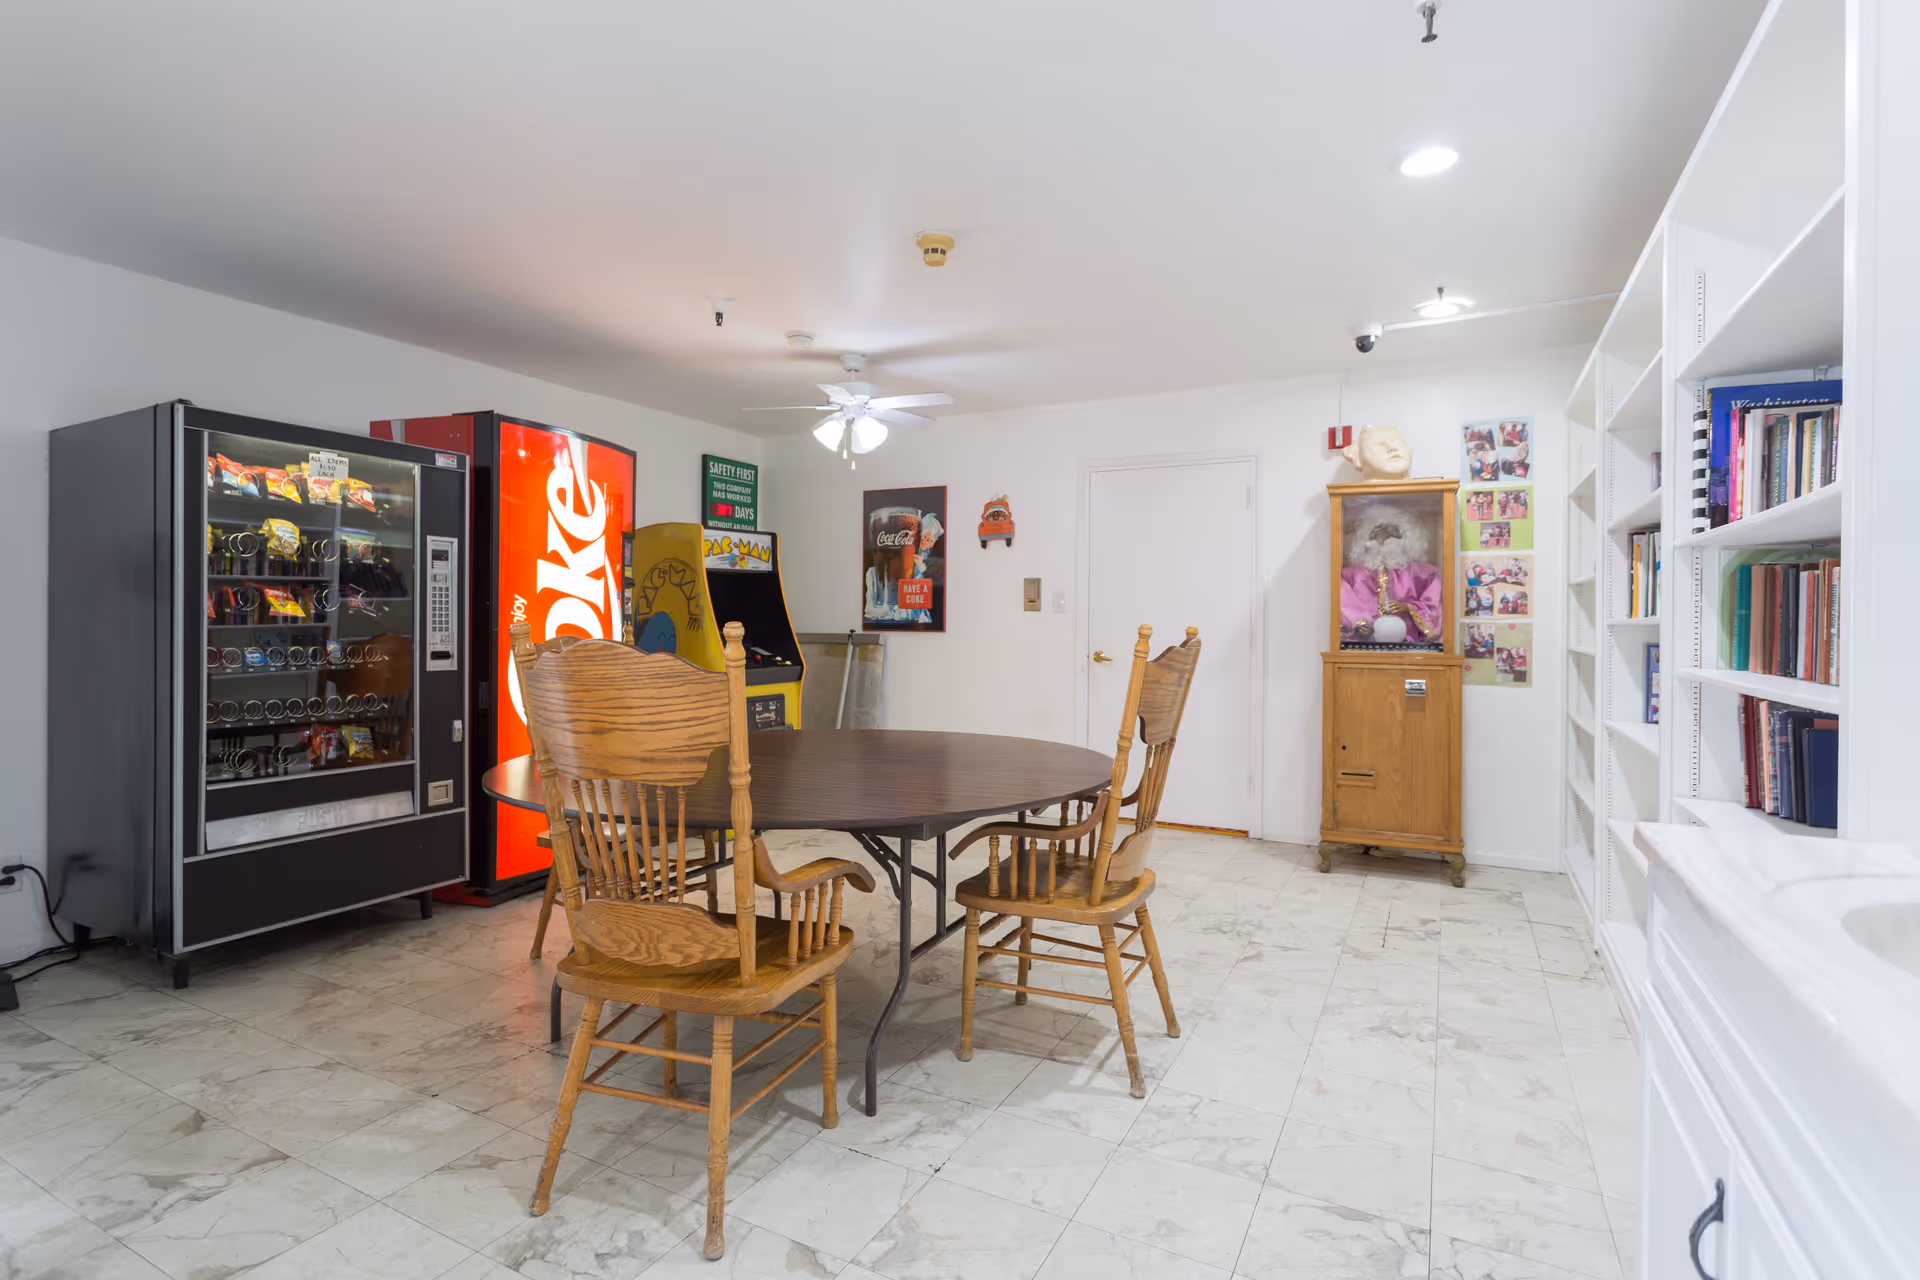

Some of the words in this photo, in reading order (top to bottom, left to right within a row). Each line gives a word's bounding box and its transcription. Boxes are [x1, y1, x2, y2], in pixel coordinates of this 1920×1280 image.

[327, 458, 348, 467] ITEMS
[709, 461, 736, 477] SAFETY
[736, 467, 756, 482] FIRST
[713, 481, 726, 491] THIS
[726, 484, 752, 495] COMPANY
[712, 490, 726, 499] HAS
[726, 492, 752, 503] WORKED
[735, 505, 755, 520] DAYS
[708, 520, 733, 529] WITHOUT
[876, 529, 916, 547] Coca-Cola
[703, 535, 771, 564] PAC-MAN
[903, 584, 921, 593] HAVE
[922, 584, 929, 593] A
[905, 594, 925, 604] COKE
[510, 594, 527, 624] njoy
